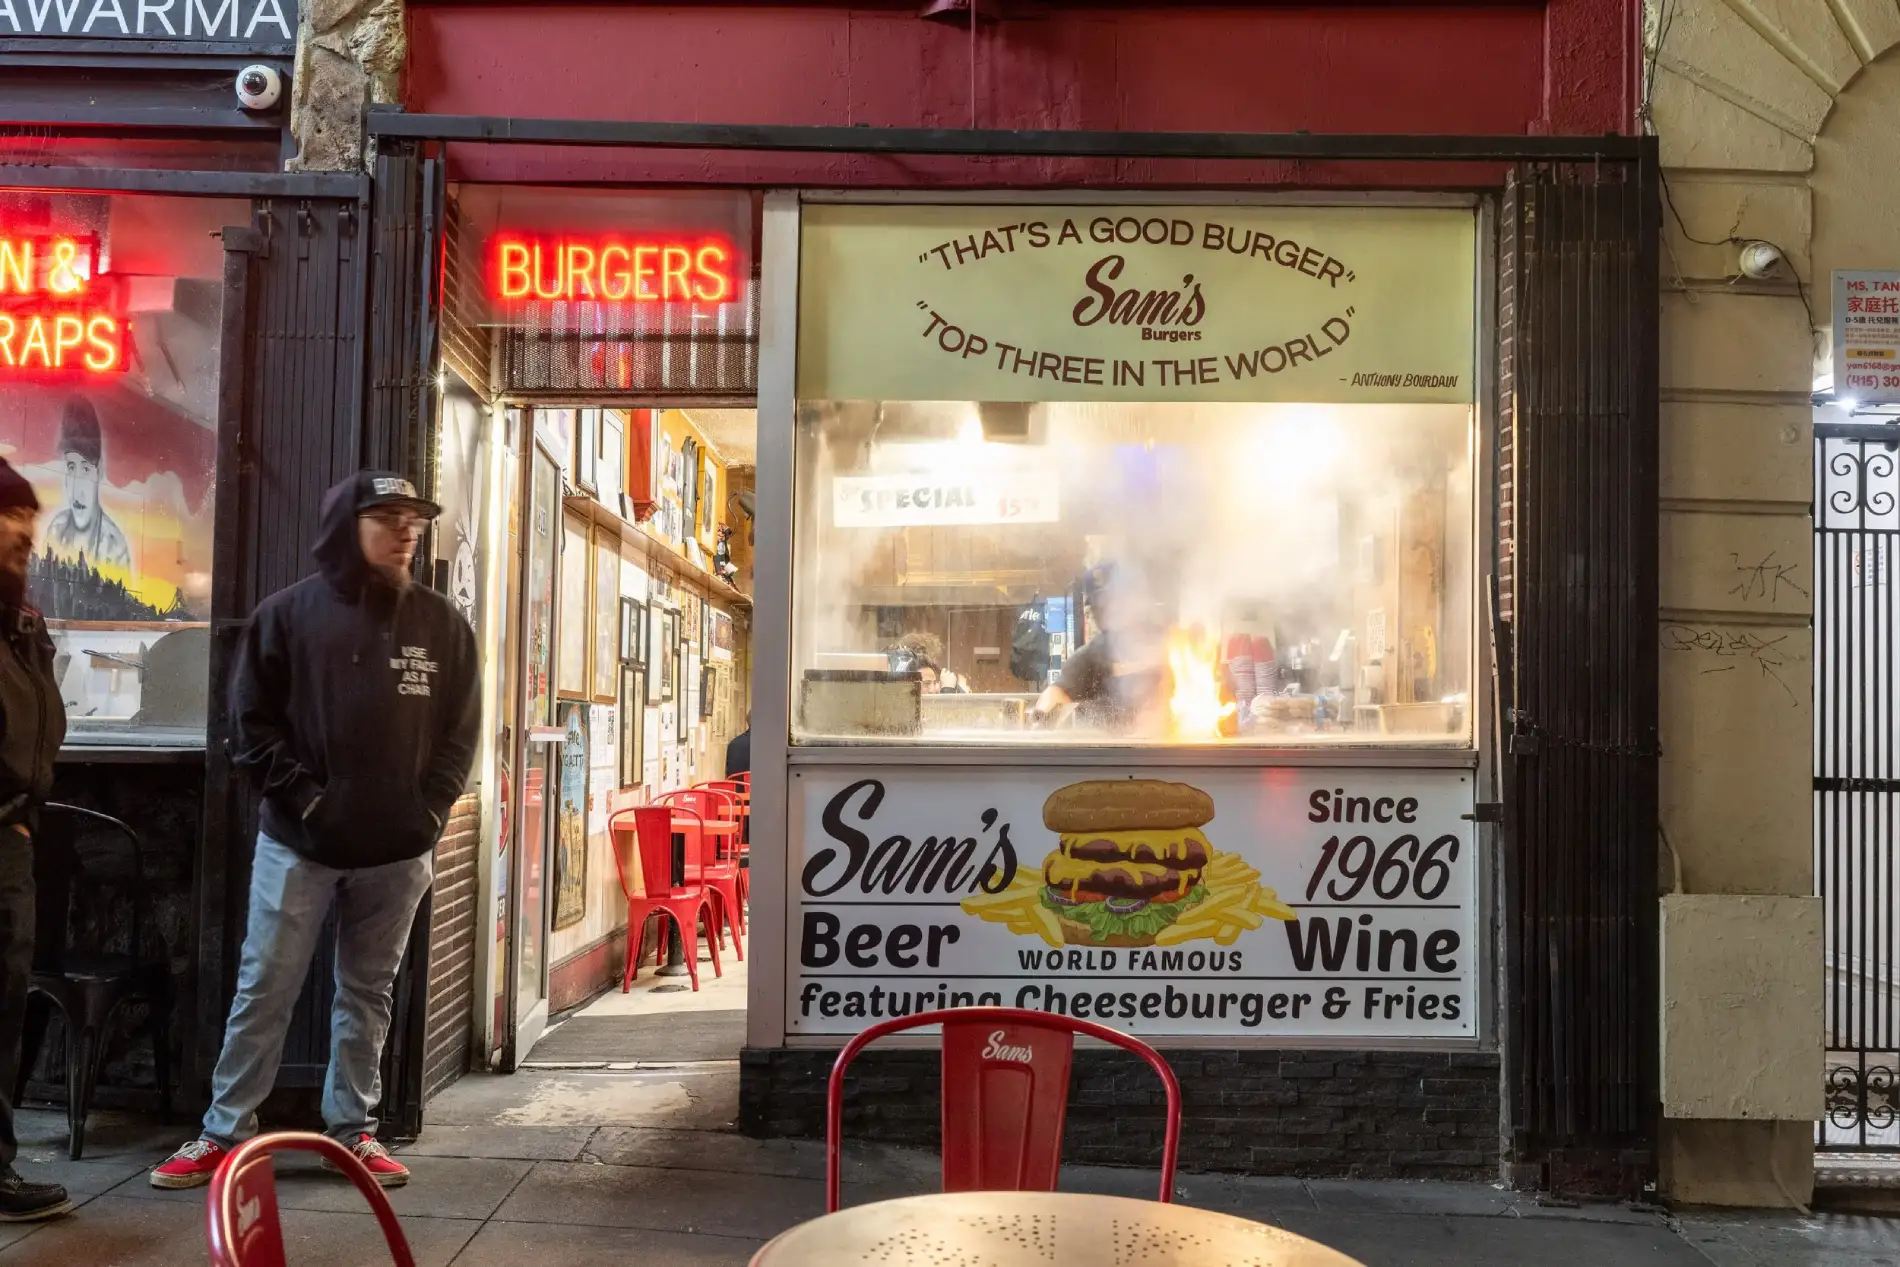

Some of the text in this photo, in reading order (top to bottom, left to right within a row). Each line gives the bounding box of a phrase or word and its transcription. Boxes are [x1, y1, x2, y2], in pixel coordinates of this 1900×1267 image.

[47, 239, 84, 294] &
[500, 241, 727, 302] BURGERS
[918, 216, 1356, 289] "THAT'S A GOOD BURGER"
[1072, 254, 1206, 327] Sam's
[916, 300, 1356, 387] "TOP THREE IN THE WORLD"
[1141, 327, 1202, 343] Burgers
[1351, 372, 1403, 388] ANTHONY
[1403, 373, 1459, 389] BOURDAIN
[1846, 374, 1879, 390] (415)
[859, 487, 977, 514] SPECIAL
[401, 646, 428, 660] USE
[409, 658, 440, 674] FACE
[1308, 788, 1419, 824] Since
[802, 779, 1018, 897] Sam's
[1305, 834, 1460, 902] 1966
[800, 912, 961, 969] Beer
[1018, 949, 1243, 972] WORLD FAMOUS
[1284, 914, 1461, 974] Wine
[1015, 984, 1312, 1027] Cheeseburger
[1321, 986, 1351, 1020] &
[1363, 985, 1461, 1020] Fries
[981, 1030, 1033, 1063] Sams
